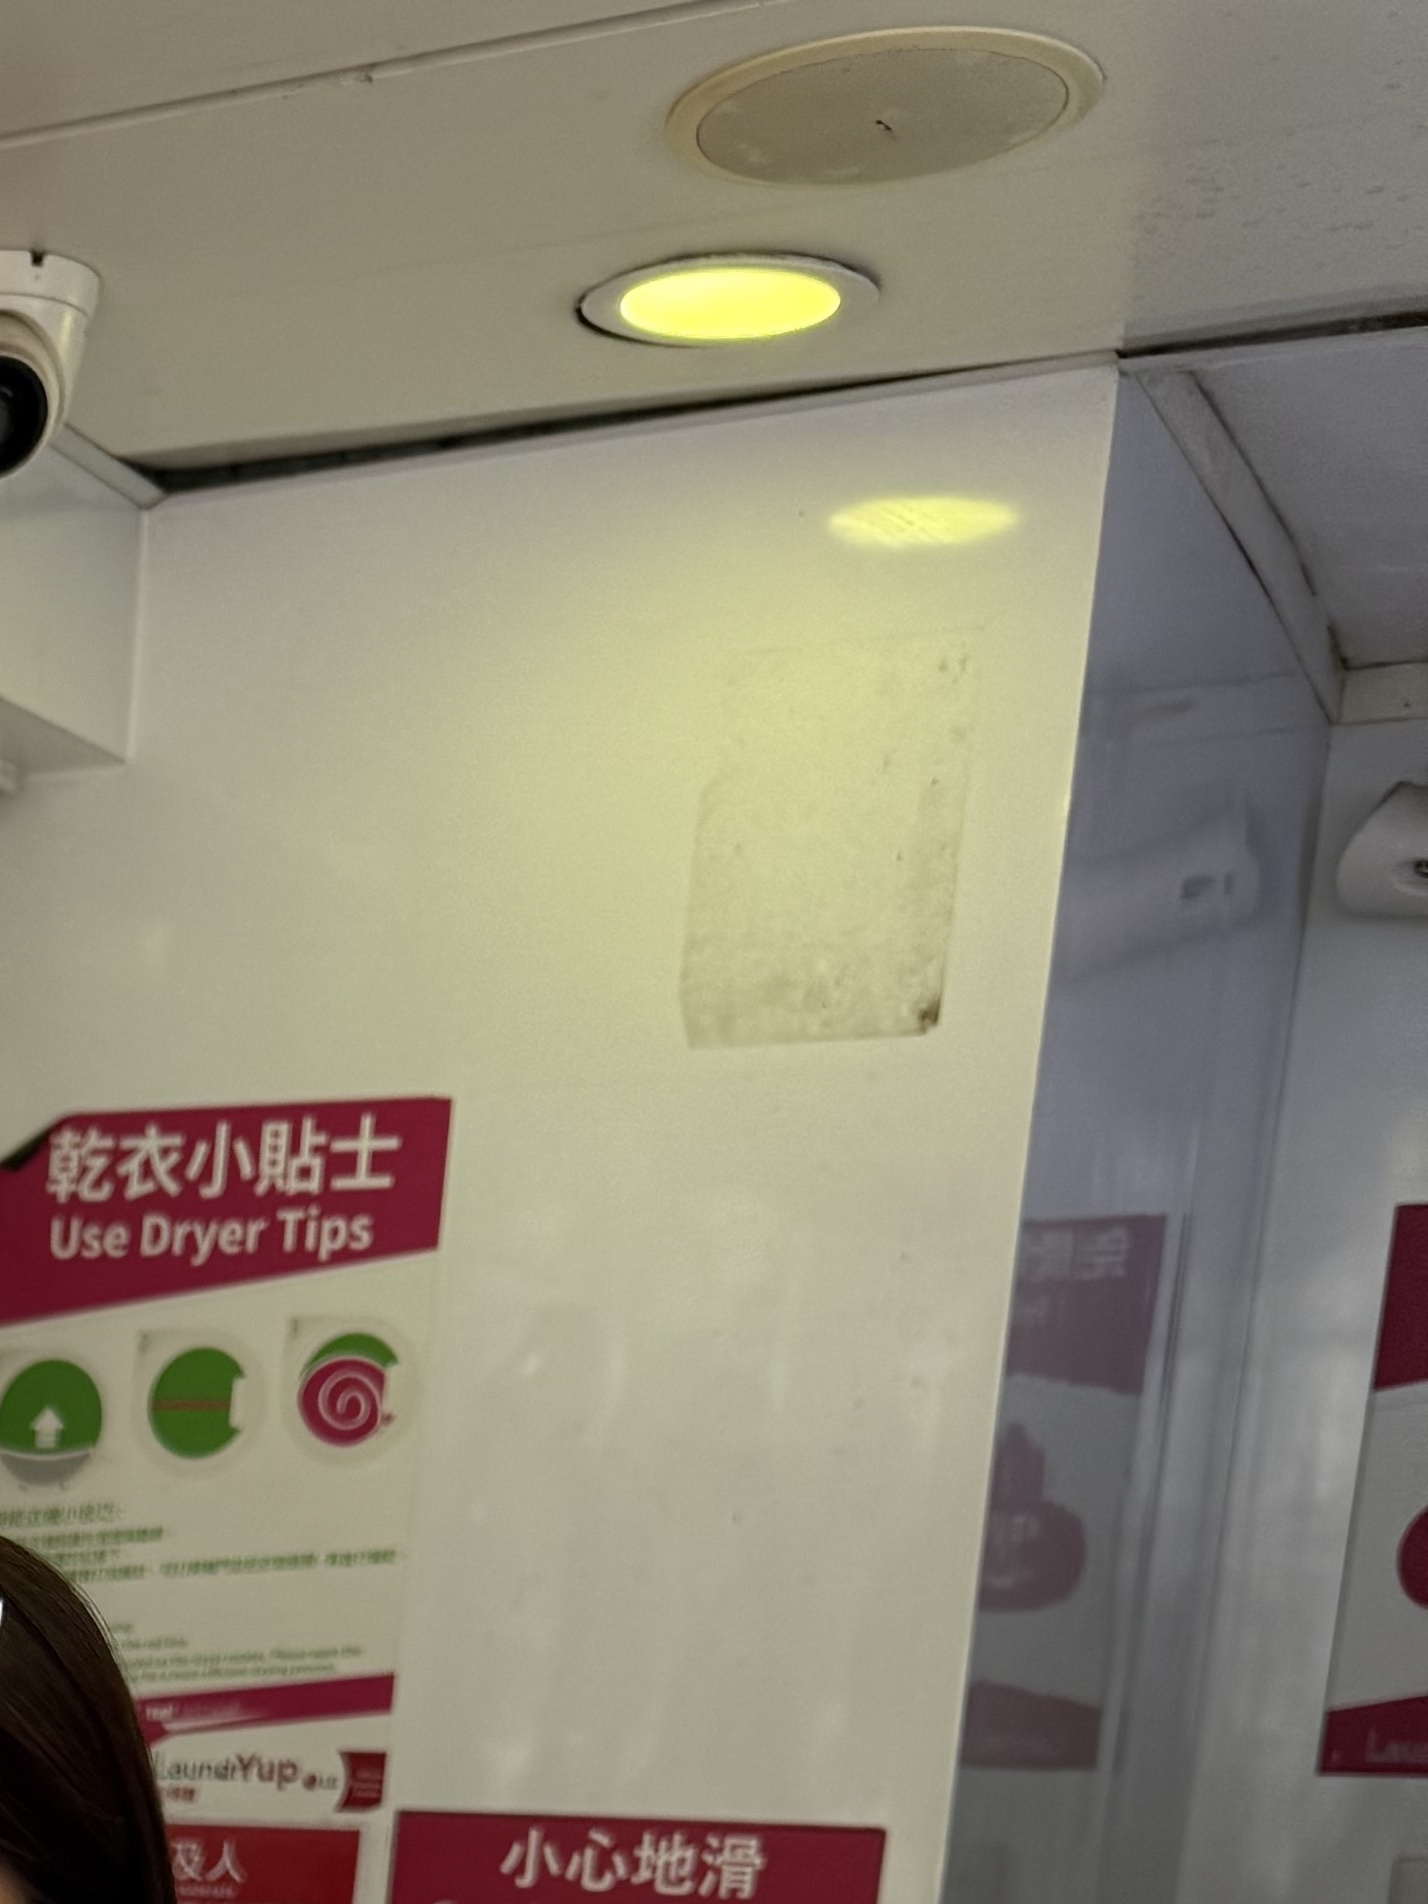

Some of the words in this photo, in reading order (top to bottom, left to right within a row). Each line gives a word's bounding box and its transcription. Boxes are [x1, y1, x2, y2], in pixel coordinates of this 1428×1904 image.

[46, 1113, 402, 1202] 乾衣小貼士
[50, 1213, 127, 1260] Use
[141, 1211, 264, 1266] Dryer
[280, 1207, 373, 1262] Tips
[499, 1828, 766, 1899] 小心地滑
